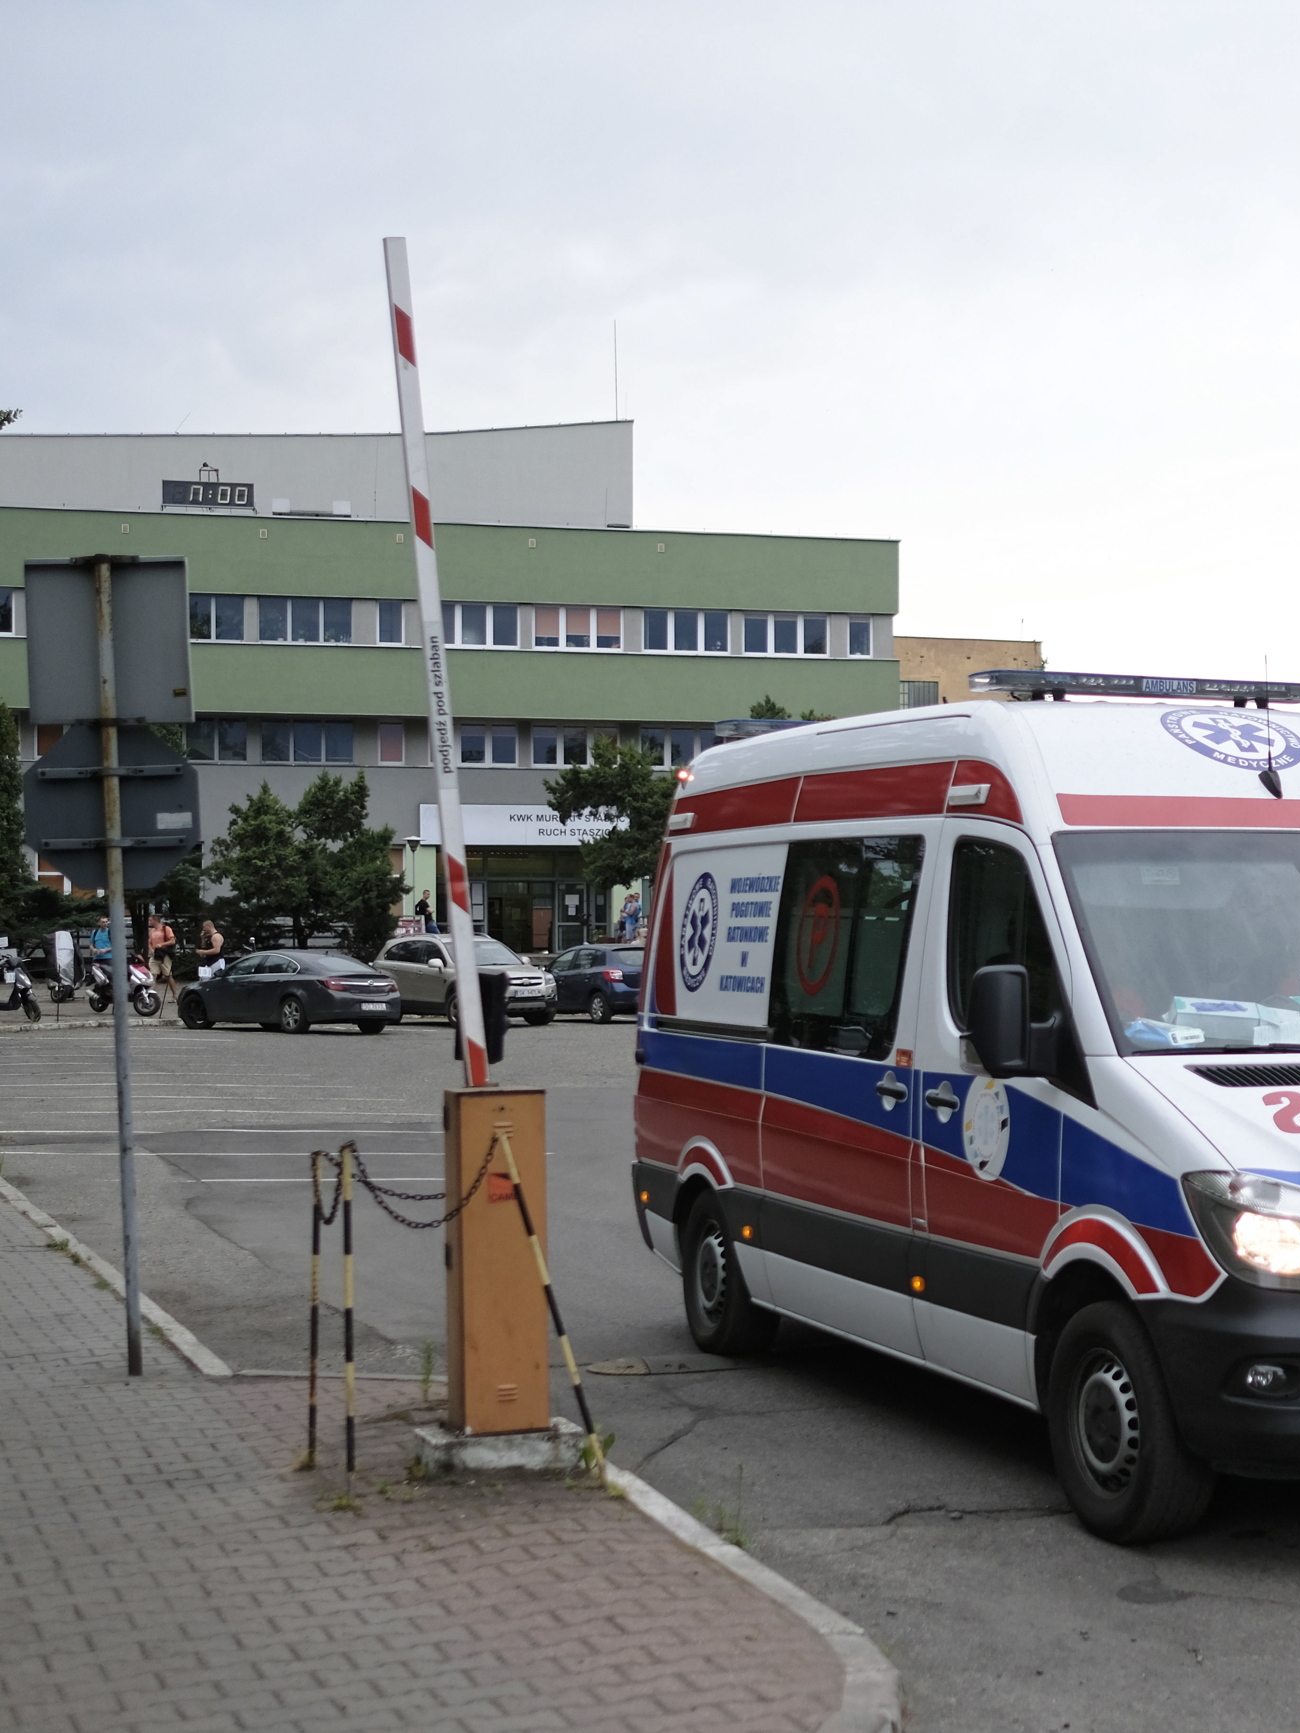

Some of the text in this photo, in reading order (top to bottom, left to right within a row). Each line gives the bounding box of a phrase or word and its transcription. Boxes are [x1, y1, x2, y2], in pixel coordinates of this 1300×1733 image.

[430, 635, 443, 687] szlaban
[1145, 679, 1195, 693] AMBULANS
[433, 691, 449, 716] pod
[1212, 751, 1295, 769] MEDYCZNE
[509, 814, 533, 822] KWK
[536, 814, 576, 822] MURKI
[538, 828, 567, 837] RUCH
[730, 873, 781, 894] WOJEWÓDZKIE
[730, 901, 773, 918] POGOTOWIE
[726, 926, 770, 943] RATUNKOWE
[740, 951, 749, 968] W
[719, 975, 766, 994] KATOWICACH
